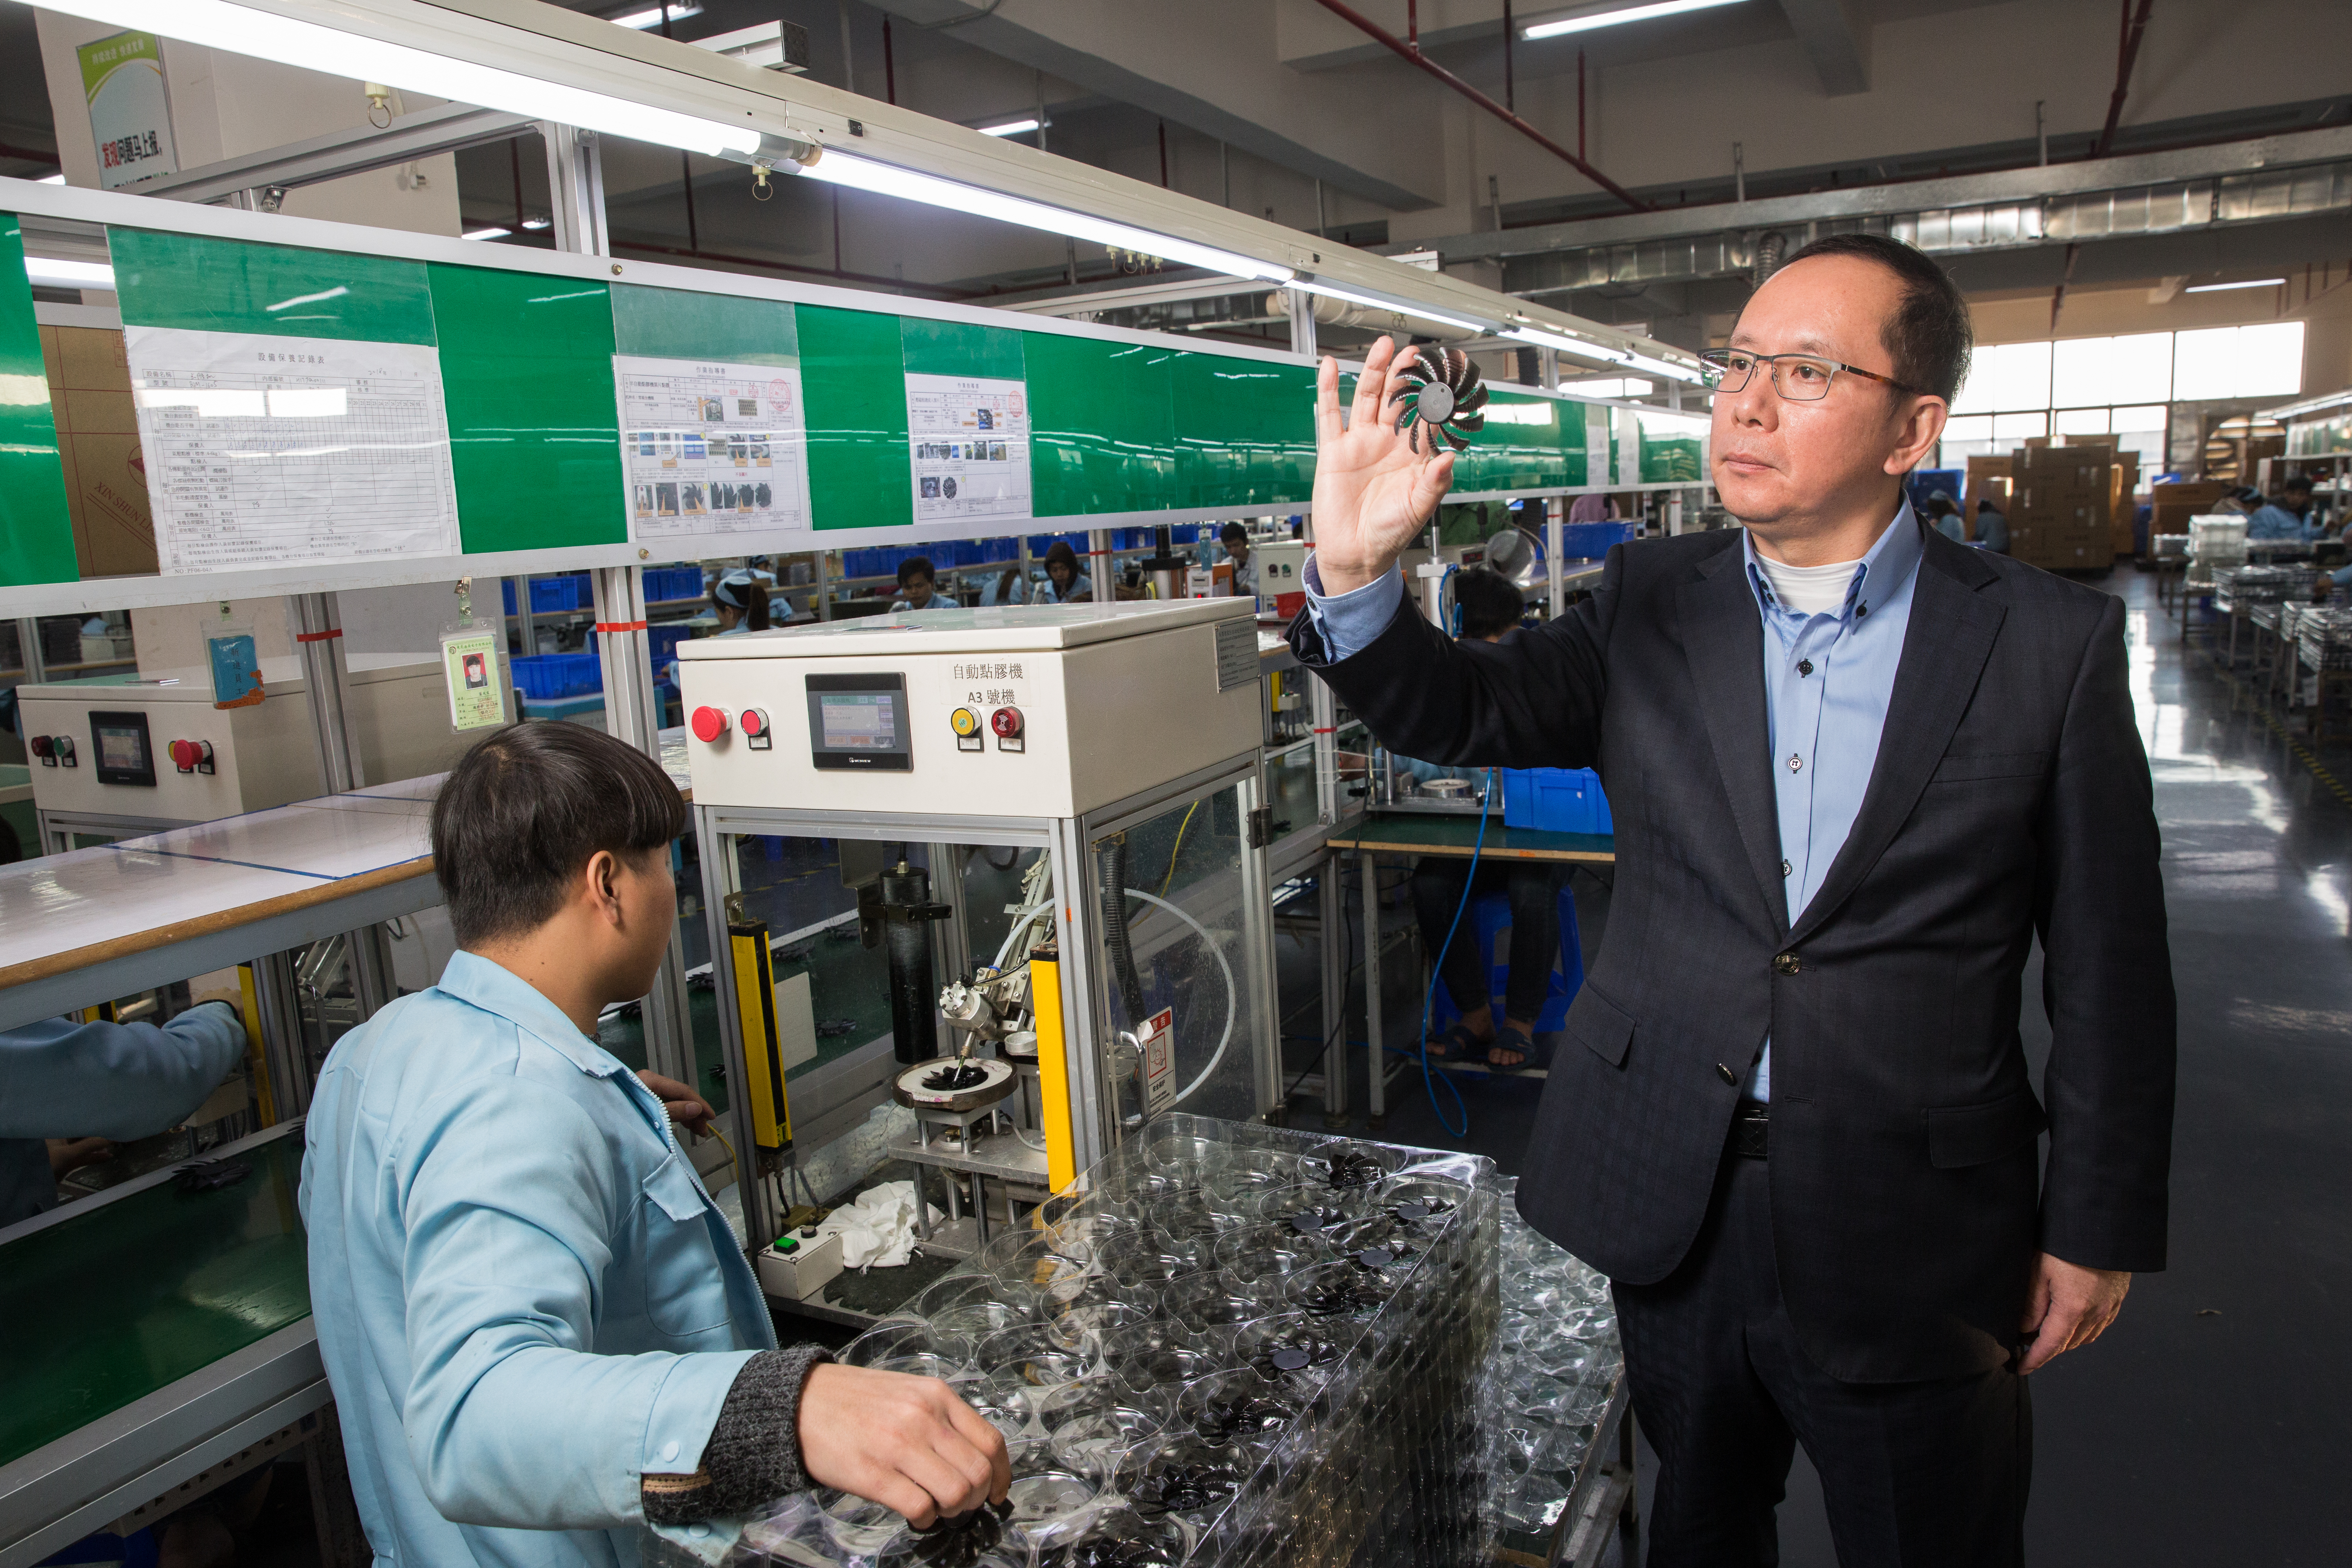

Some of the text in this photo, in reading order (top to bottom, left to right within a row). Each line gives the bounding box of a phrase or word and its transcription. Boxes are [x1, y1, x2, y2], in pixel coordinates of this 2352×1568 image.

[258, 352, 325, 364] 設備保養記錄表
[696, 366, 726, 374] 作業指導書
[154, 429, 160, 441] 每日
[94, 482, 116, 500] XIN
[113, 497, 142, 521] SHUN
[954, 663, 1023, 679] 自動點膠機
[968, 688, 1016, 705] A3 號機
